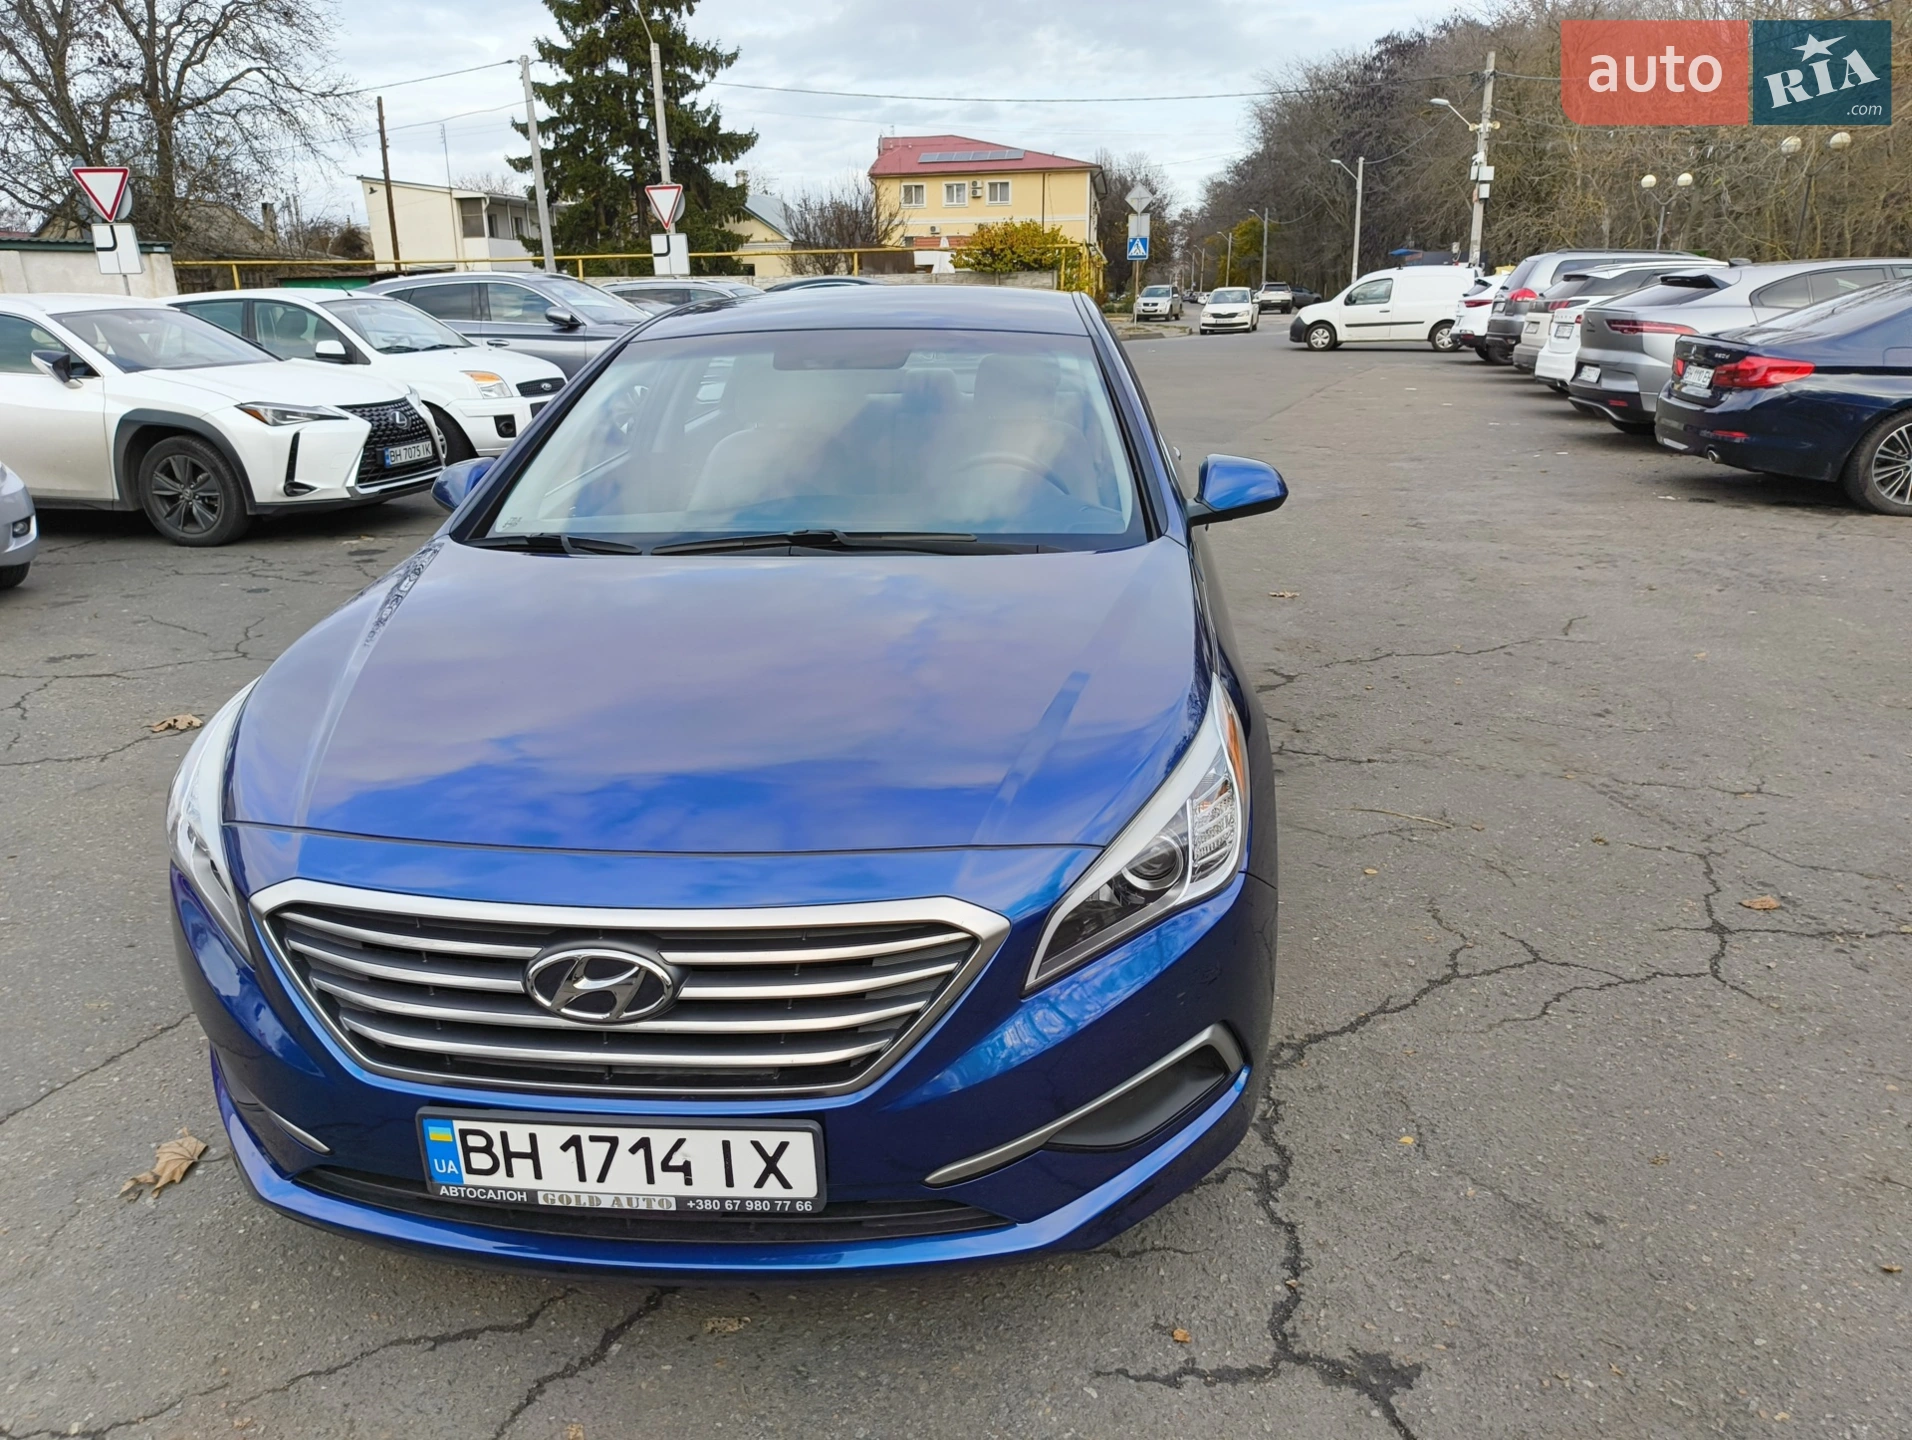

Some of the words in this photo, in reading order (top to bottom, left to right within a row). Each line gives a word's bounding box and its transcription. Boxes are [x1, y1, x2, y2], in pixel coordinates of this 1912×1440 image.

[389, 449, 402, 463] BH
[403, 445, 421, 460] 7075
[422, 443, 431, 456] IK
[433, 1158, 460, 1175] UA
[458, 1128, 543, 1180] BH
[559, 1134, 693, 1186] 1714
[721, 1139, 794, 1190] IX
[439, 1185, 528, 1202] АВТОСАЛОН
[542, 1192, 602, 1207] GOLD
[610, 1196, 673, 1210] AUTO
[686, 1200, 720, 1210] +380
[724, 1200, 741, 1211] 67
[745, 1200, 771, 1211] 980
[774, 1201, 791, 1211] 77
[795, 1201, 813, 1212] 66
